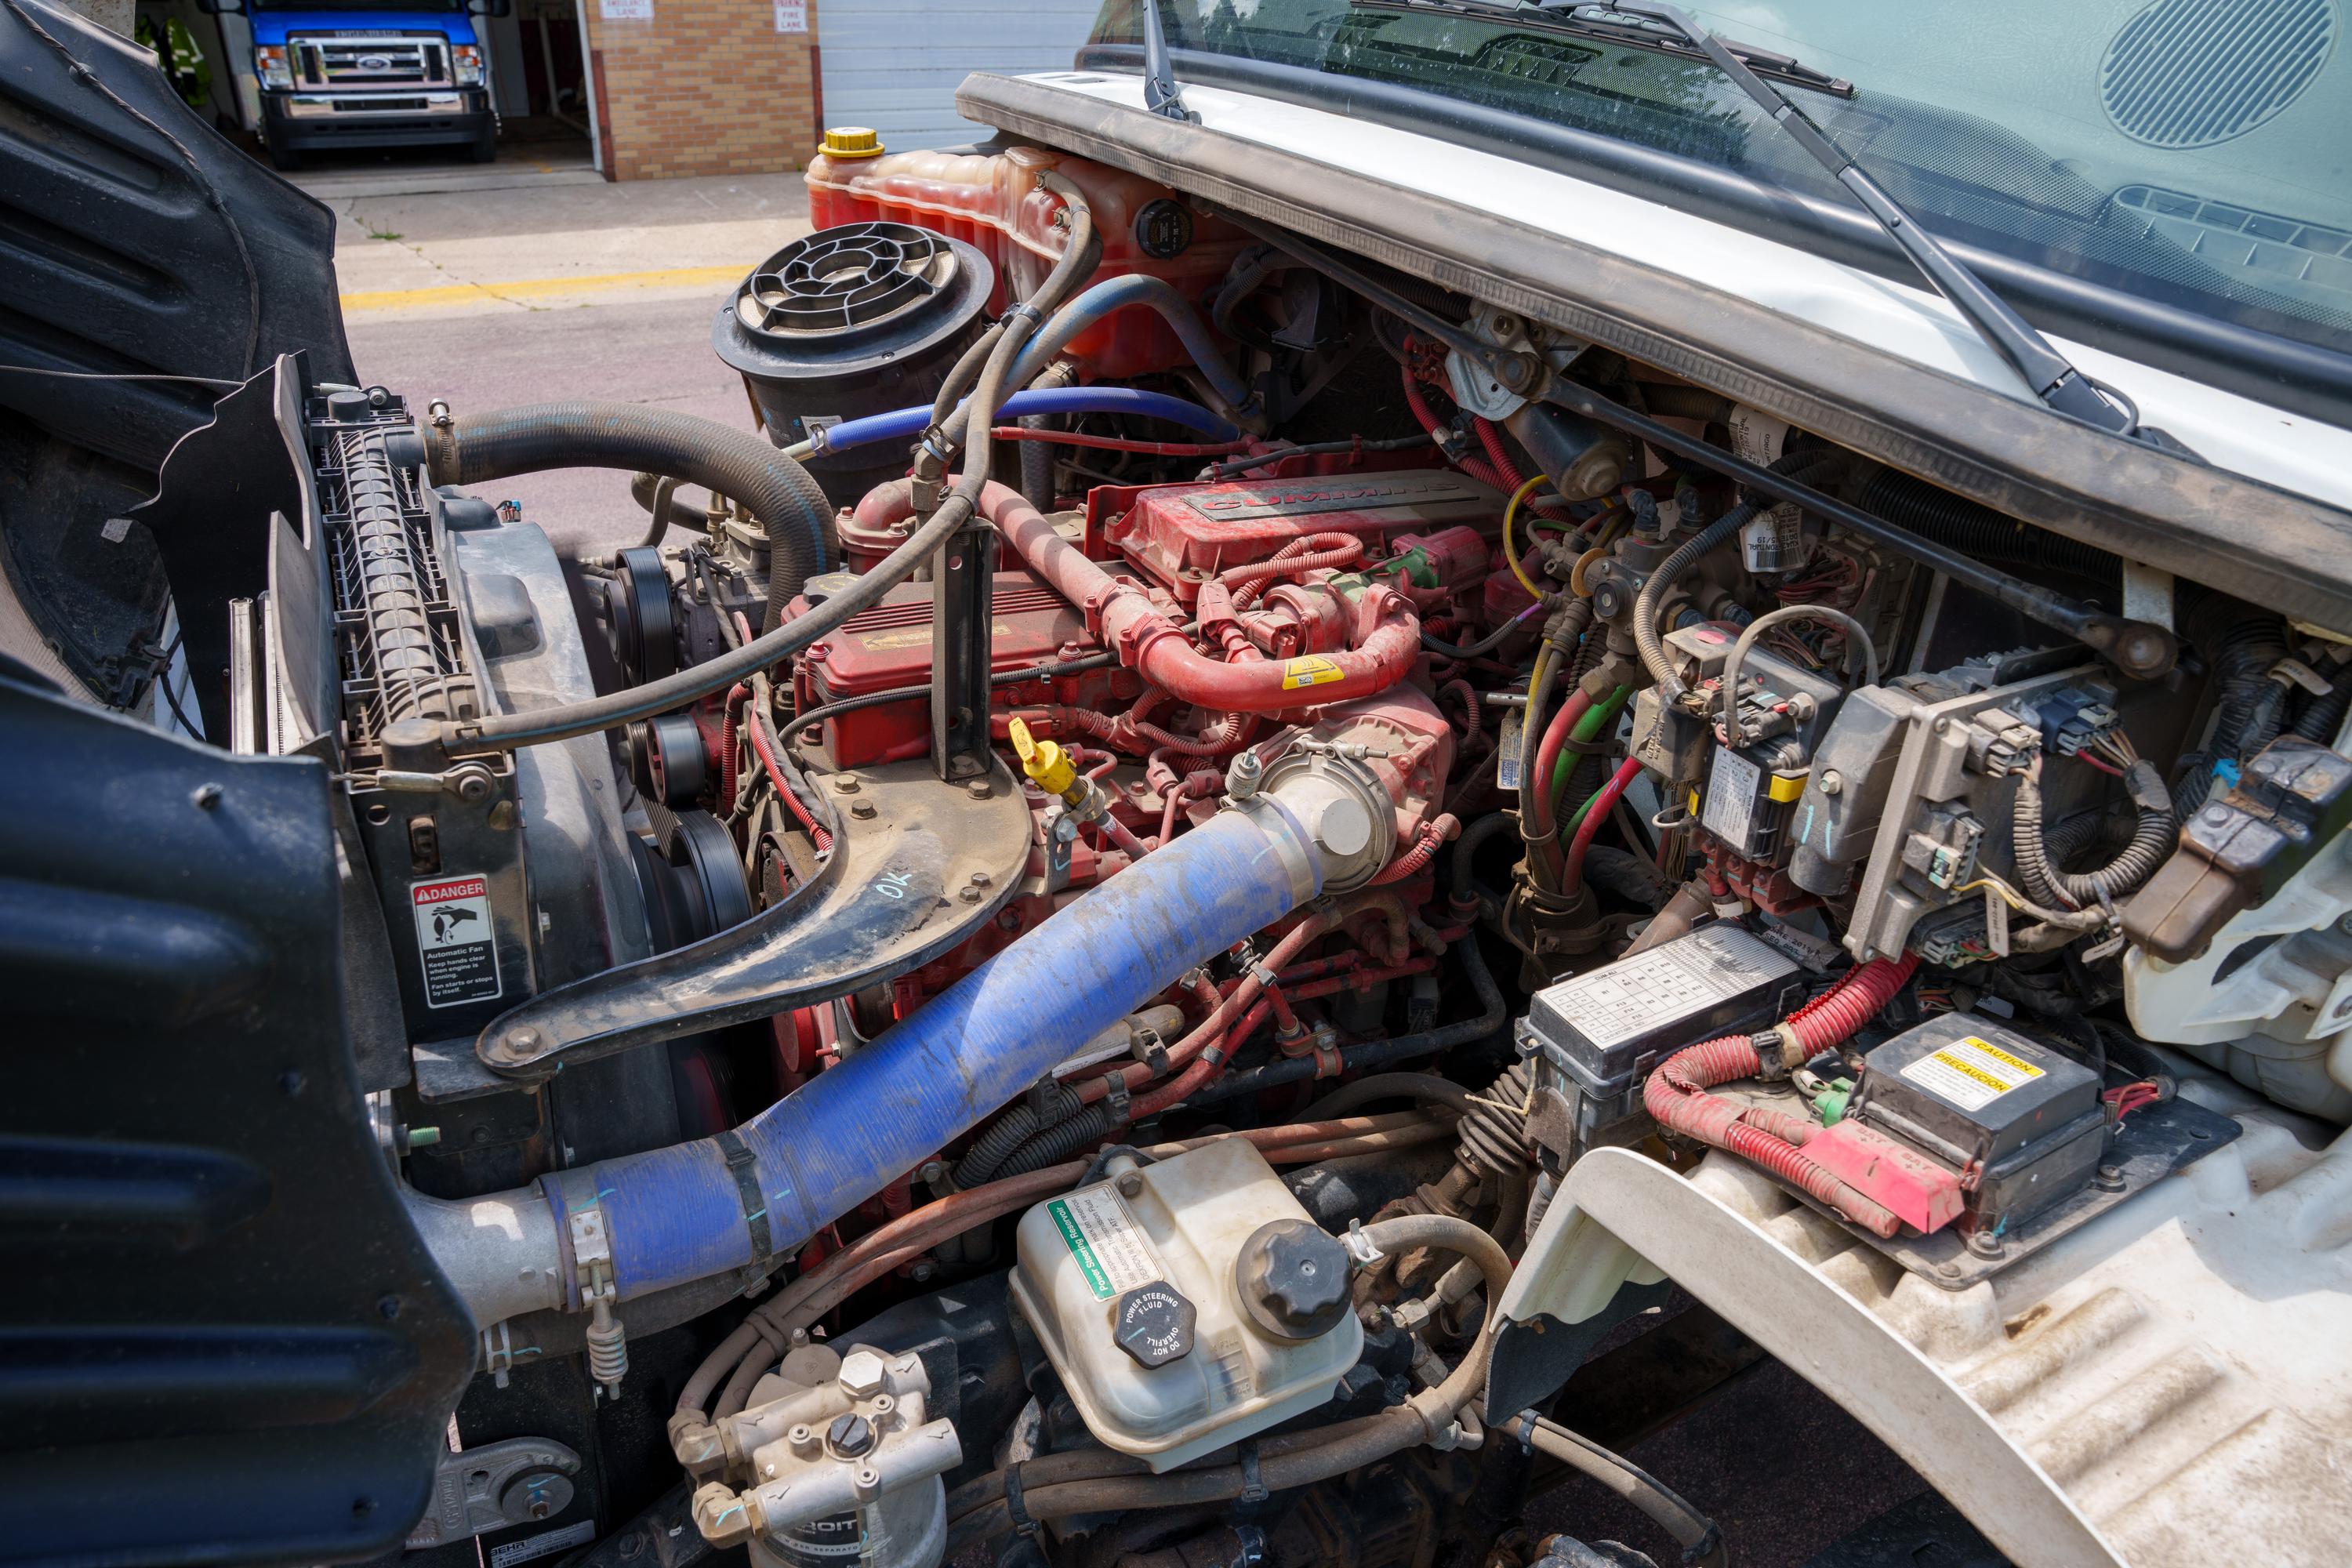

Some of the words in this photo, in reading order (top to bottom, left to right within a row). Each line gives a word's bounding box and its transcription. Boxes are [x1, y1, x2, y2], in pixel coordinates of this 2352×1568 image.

[1201, 483, 1461, 510] CUMMINS
[431, 884, 484, 899] DANGER
[876, 872, 912, 898] OK
[427, 948, 467, 959] Automatic
[430, 966, 447, 975] when
[448, 964, 471, 973] engine
[430, 972, 458, 981] running.
[1976, 1043, 2032, 1072] CAUTION
[1935, 1053, 2007, 1091] PRECAUCION
[1857, 1127, 1886, 1143] BAT
[1901, 1152, 1932, 1170] BAT
[1083, 1198, 1096, 1213] Fluid
[1054, 1204, 1079, 1240] Reservoir
[1091, 1210, 1115, 1246] Transmission
[1087, 1228, 1099, 1243] mark
[1114, 1225, 1128, 1243] Super
[1073, 1237, 1096, 1269] Steering
[1094, 1241, 1117, 1273] appropriate
[1110, 1243, 1131, 1272] Automatic
[1089, 1266, 1108, 1292] Power
[1126, 1270, 1138, 1284] Use
[1127, 1298, 1142, 1323] POWER
[1142, 1293, 1178, 1307] STEERING
[1138, 1301, 1162, 1316] FLUID
[1147, 1327, 1178, 1346] OVERFILL
[1170, 1341, 1180, 1351] DO
